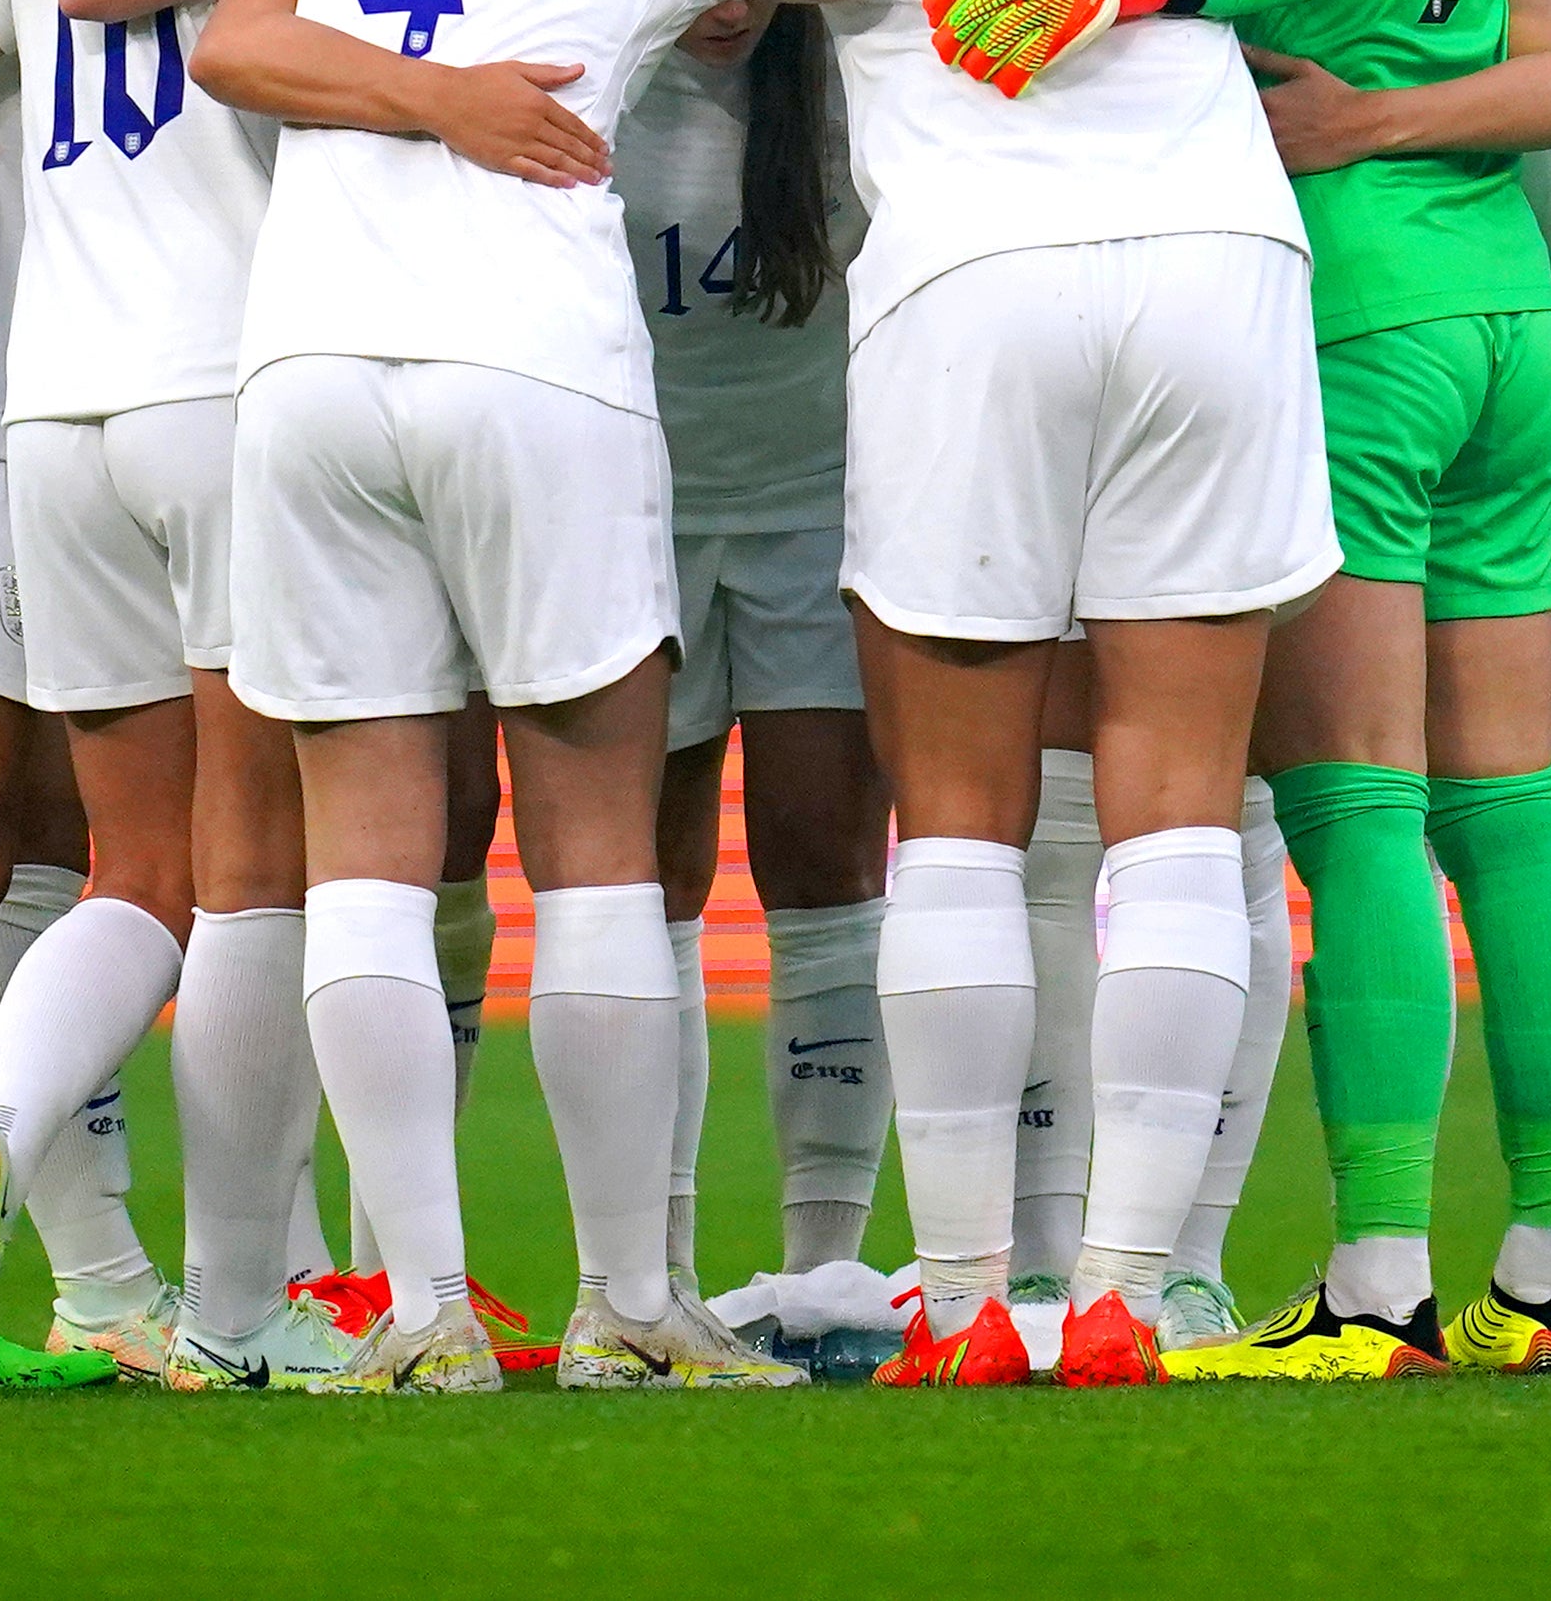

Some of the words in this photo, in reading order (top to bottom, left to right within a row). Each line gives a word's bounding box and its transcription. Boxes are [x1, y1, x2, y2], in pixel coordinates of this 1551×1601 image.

[42, 4, 185, 172] 10
[791, 1062, 864, 1085] Eng
[87, 1116, 128, 1136] En
